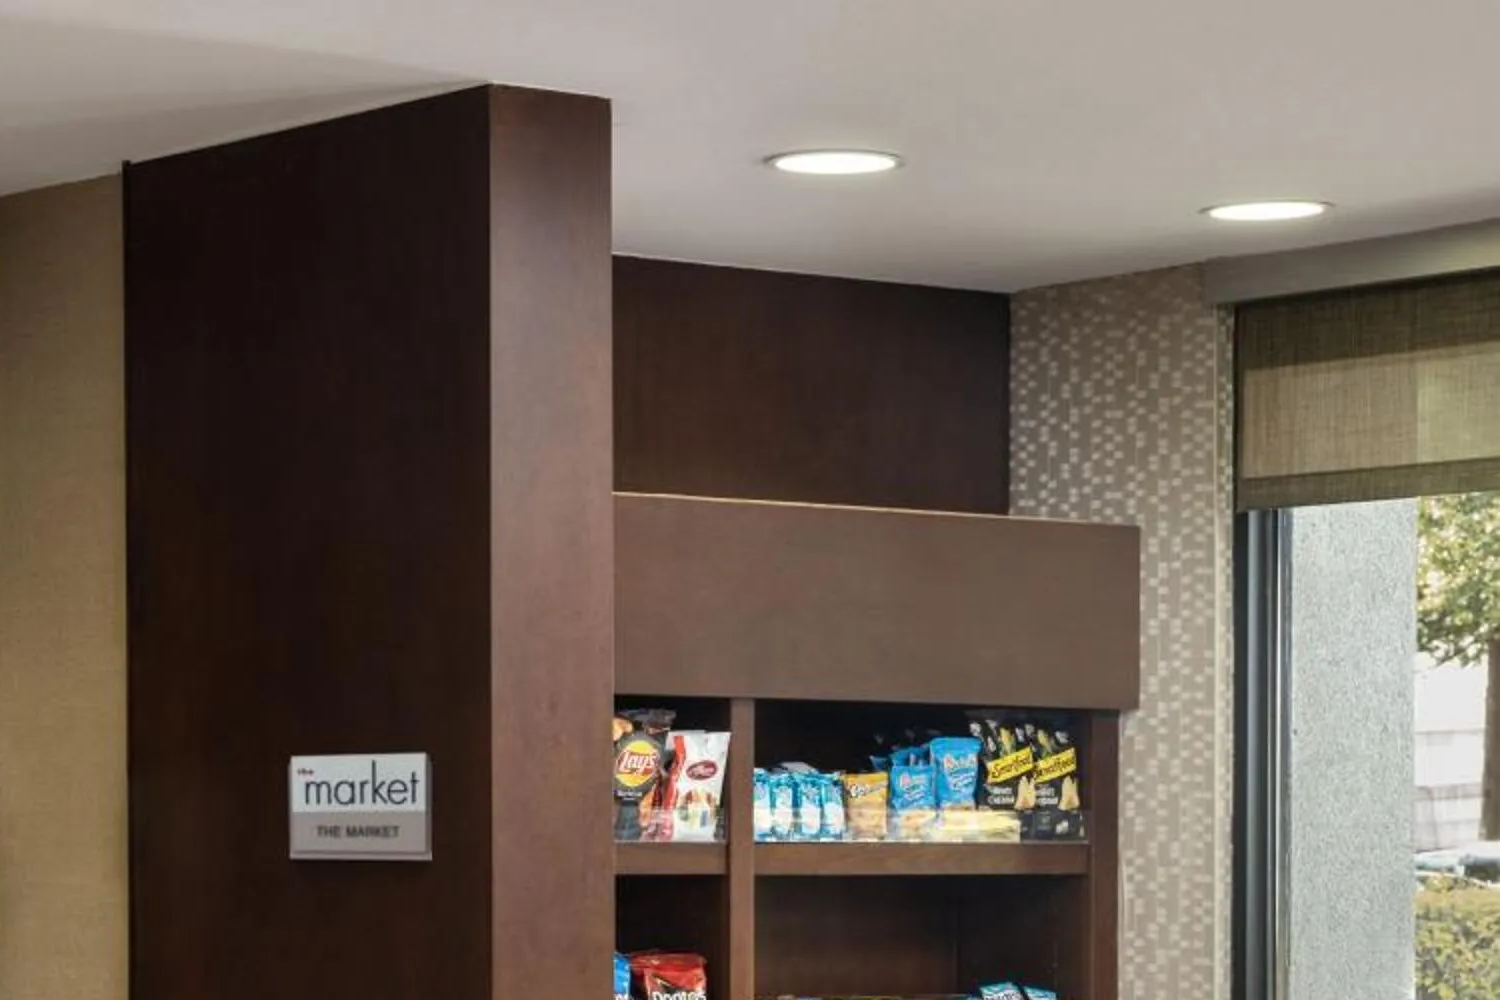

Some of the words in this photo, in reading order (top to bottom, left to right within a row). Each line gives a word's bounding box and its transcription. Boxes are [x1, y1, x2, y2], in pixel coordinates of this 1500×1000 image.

[305, 759, 420, 805] market
[316, 825, 342, 838] THE
[346, 825, 400, 838] MARKET
